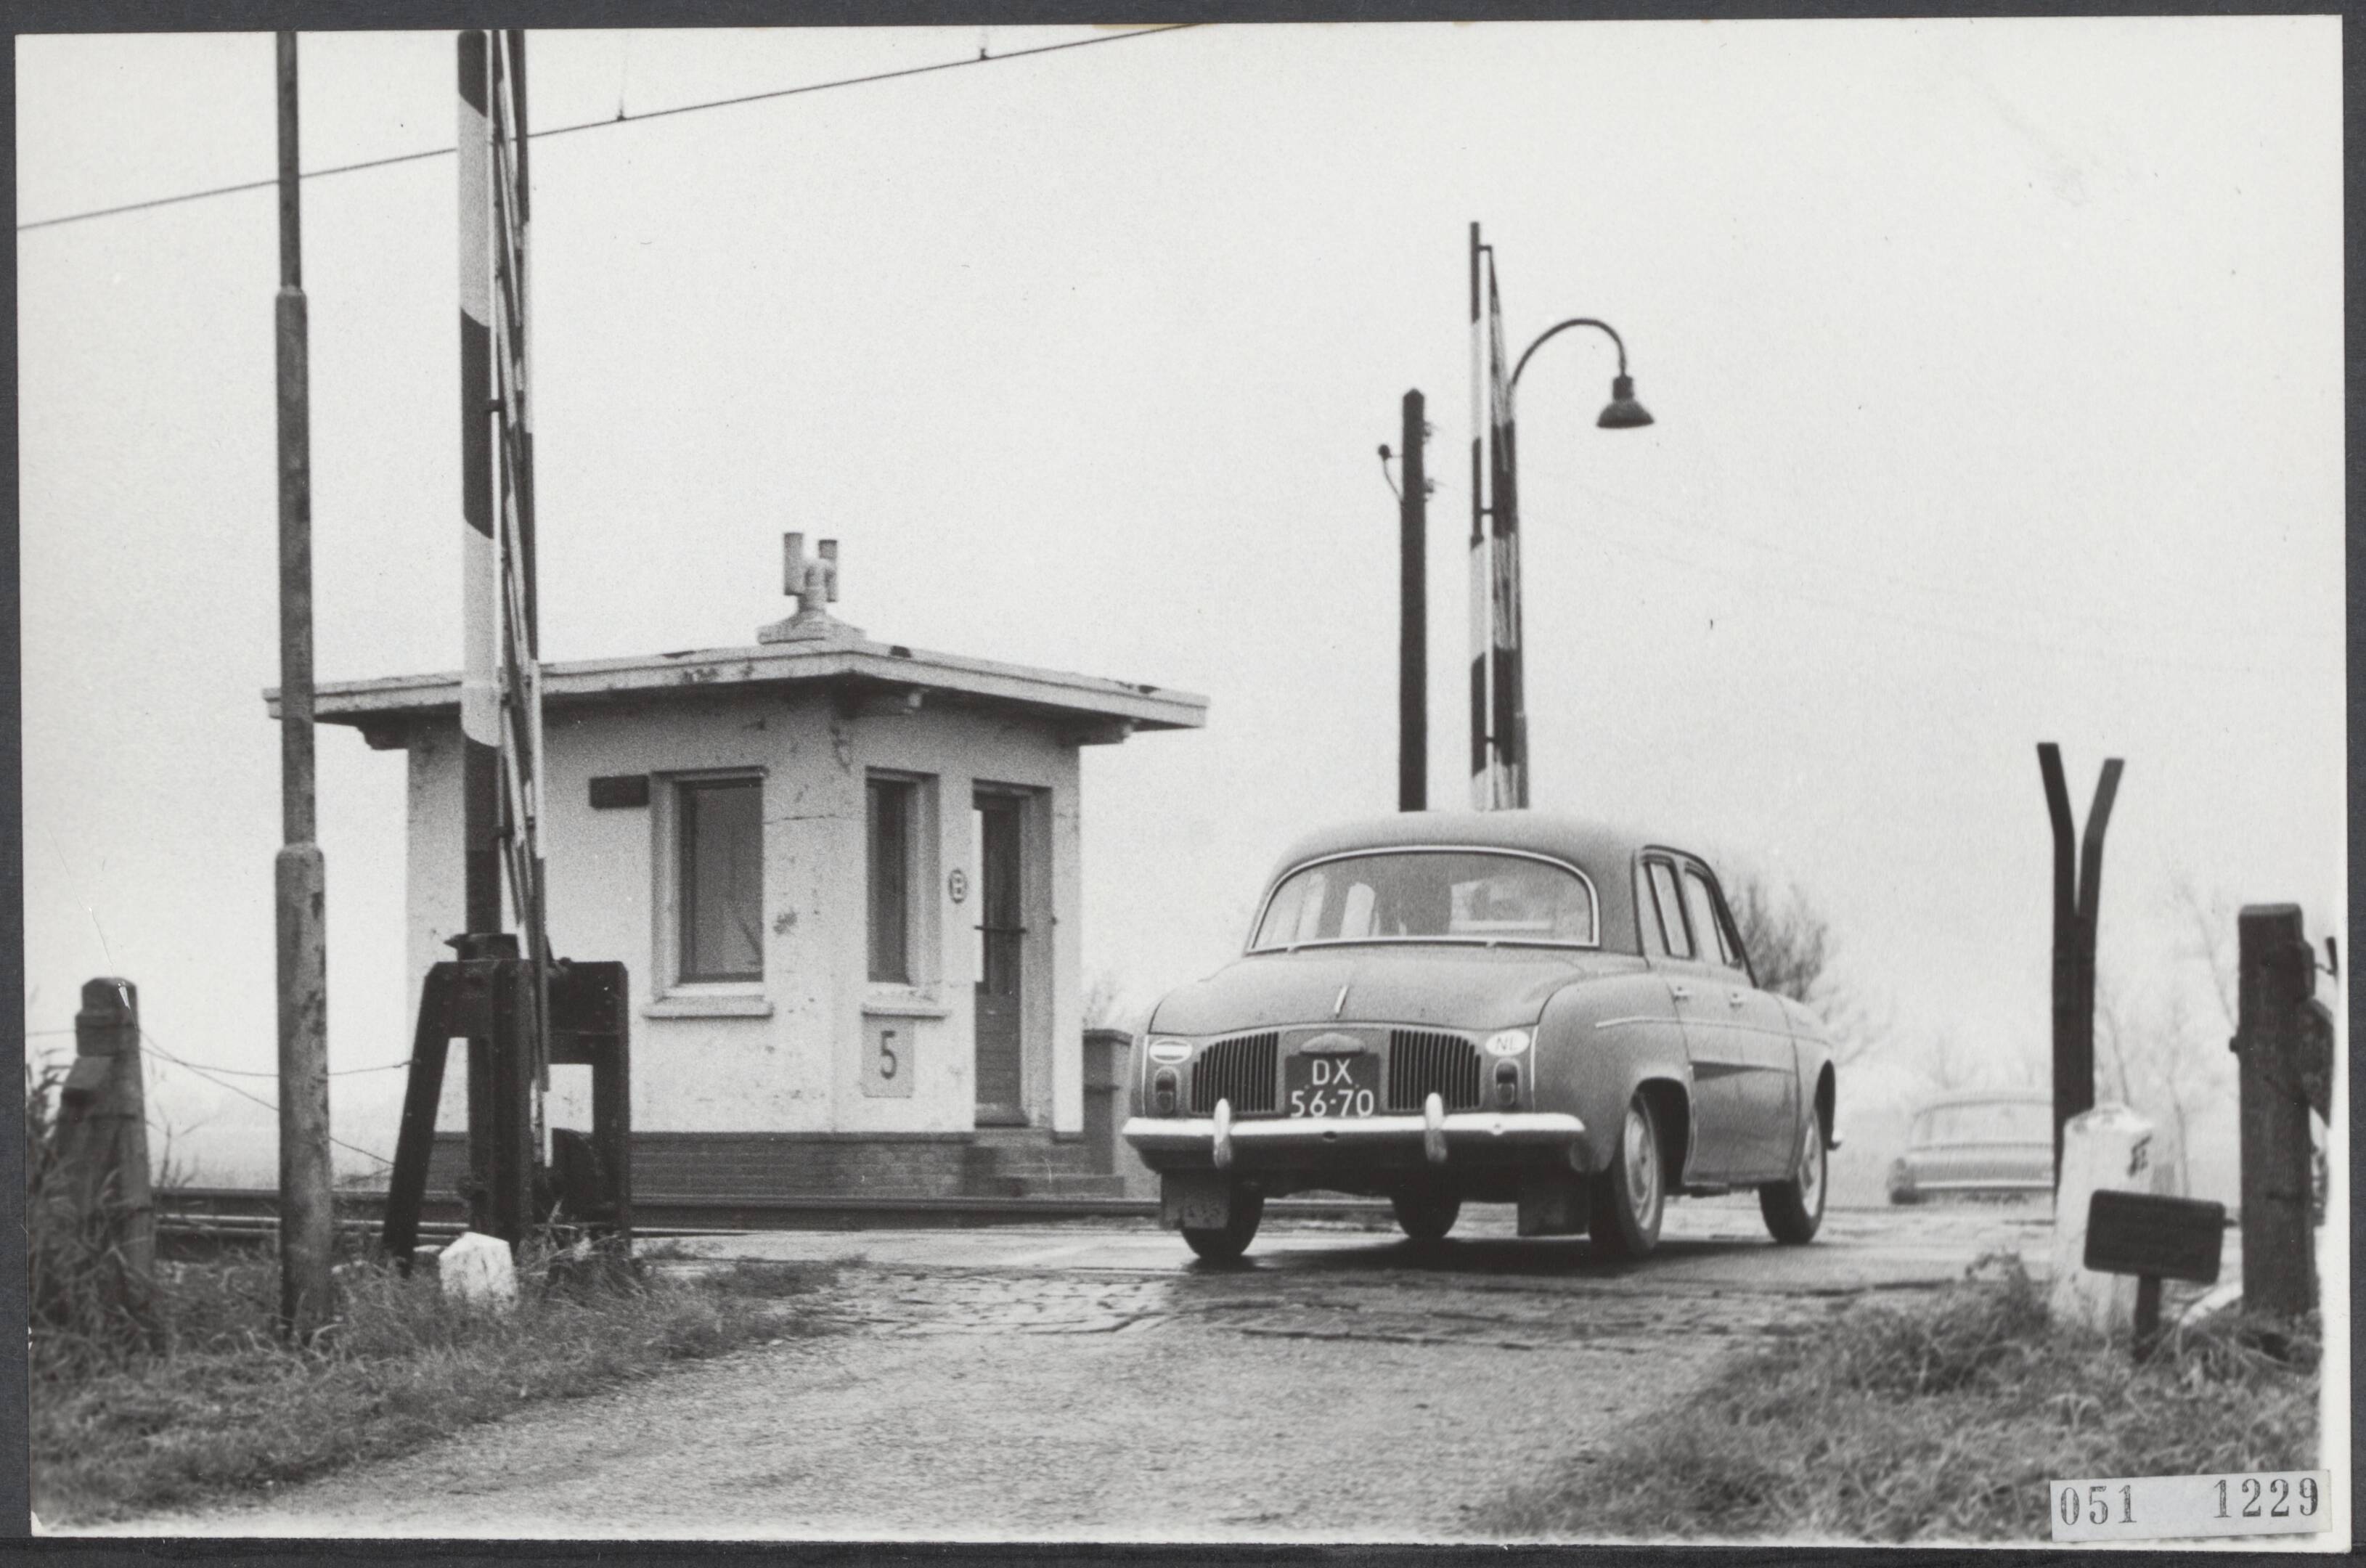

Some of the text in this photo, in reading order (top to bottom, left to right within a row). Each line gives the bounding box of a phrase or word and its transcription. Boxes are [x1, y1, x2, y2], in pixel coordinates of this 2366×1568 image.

[880, 1030, 897, 1079] 5
[1496, 1035, 1522, 1052] NL
[1312, 1058, 1353, 1085] DX
